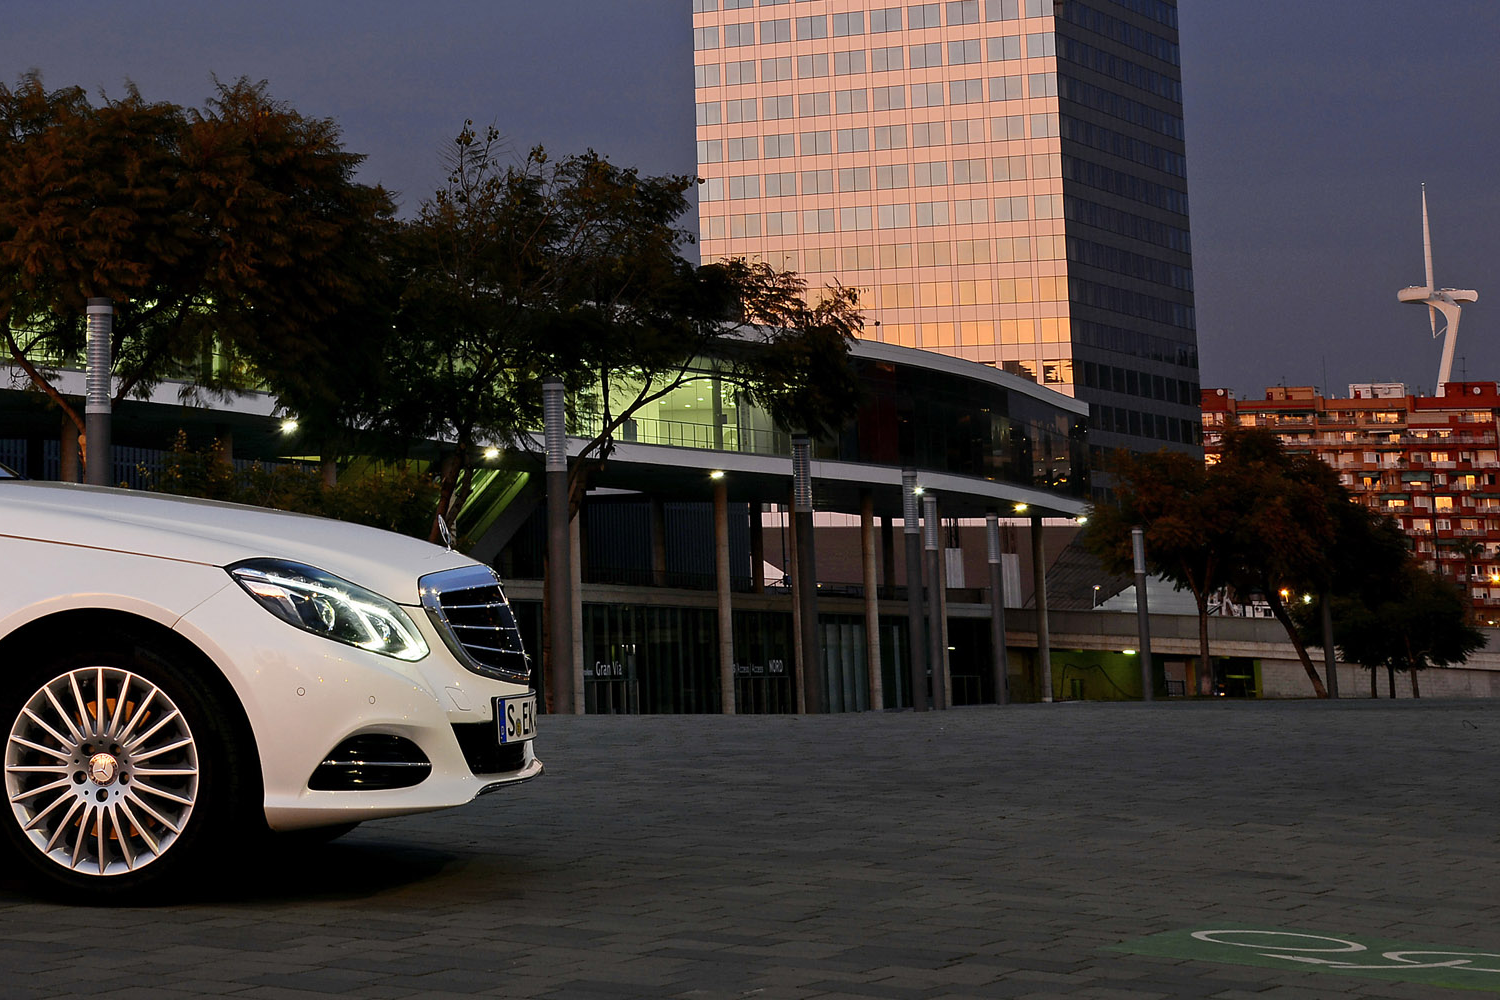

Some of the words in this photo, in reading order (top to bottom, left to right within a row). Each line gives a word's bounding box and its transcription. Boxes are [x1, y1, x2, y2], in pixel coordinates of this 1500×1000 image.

[595, 660, 612, 677] Gran
[768, 659, 784, 673] NORD
[507, 703, 515, 736] S
